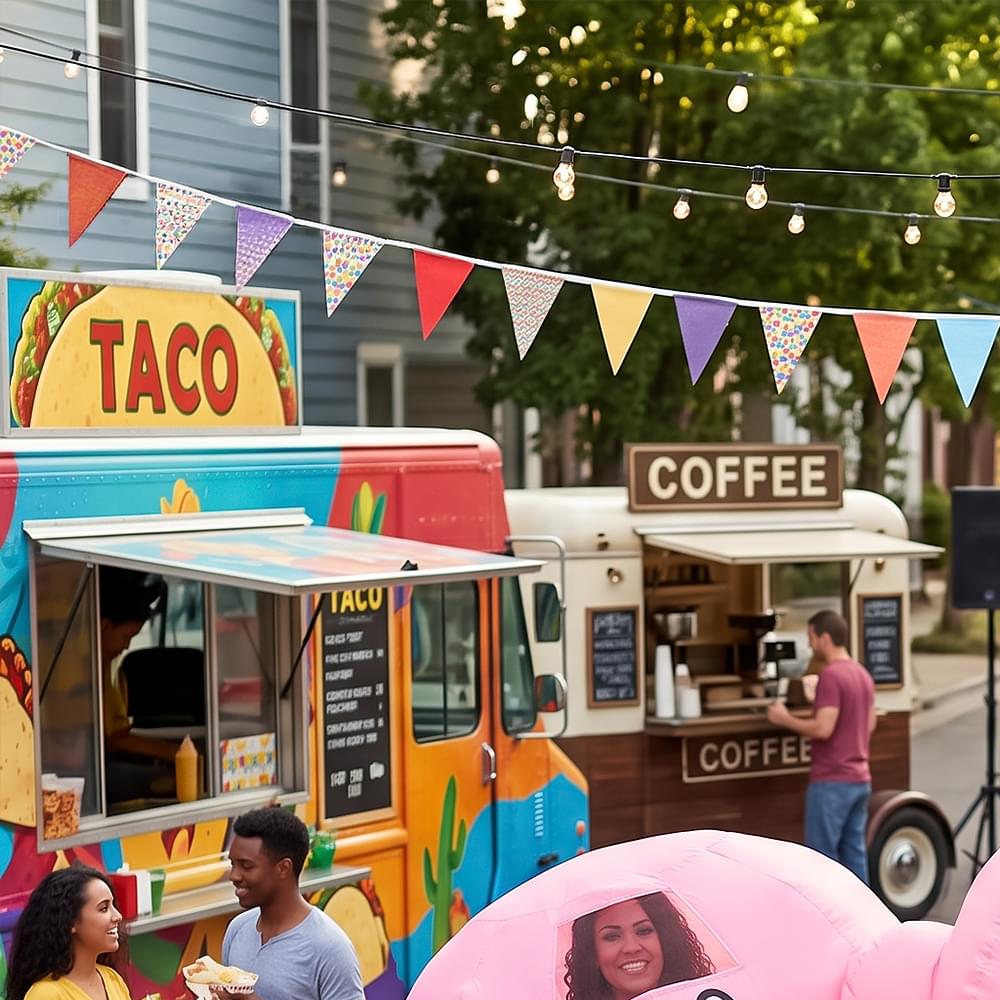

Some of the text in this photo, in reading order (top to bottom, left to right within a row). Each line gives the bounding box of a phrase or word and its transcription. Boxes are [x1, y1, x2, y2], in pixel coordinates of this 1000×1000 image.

[89, 318, 239, 417] TACO
[648, 456, 828, 500] COFFEE
[331, 587, 383, 614] TACO
[699, 737, 812, 772] COFFEE
